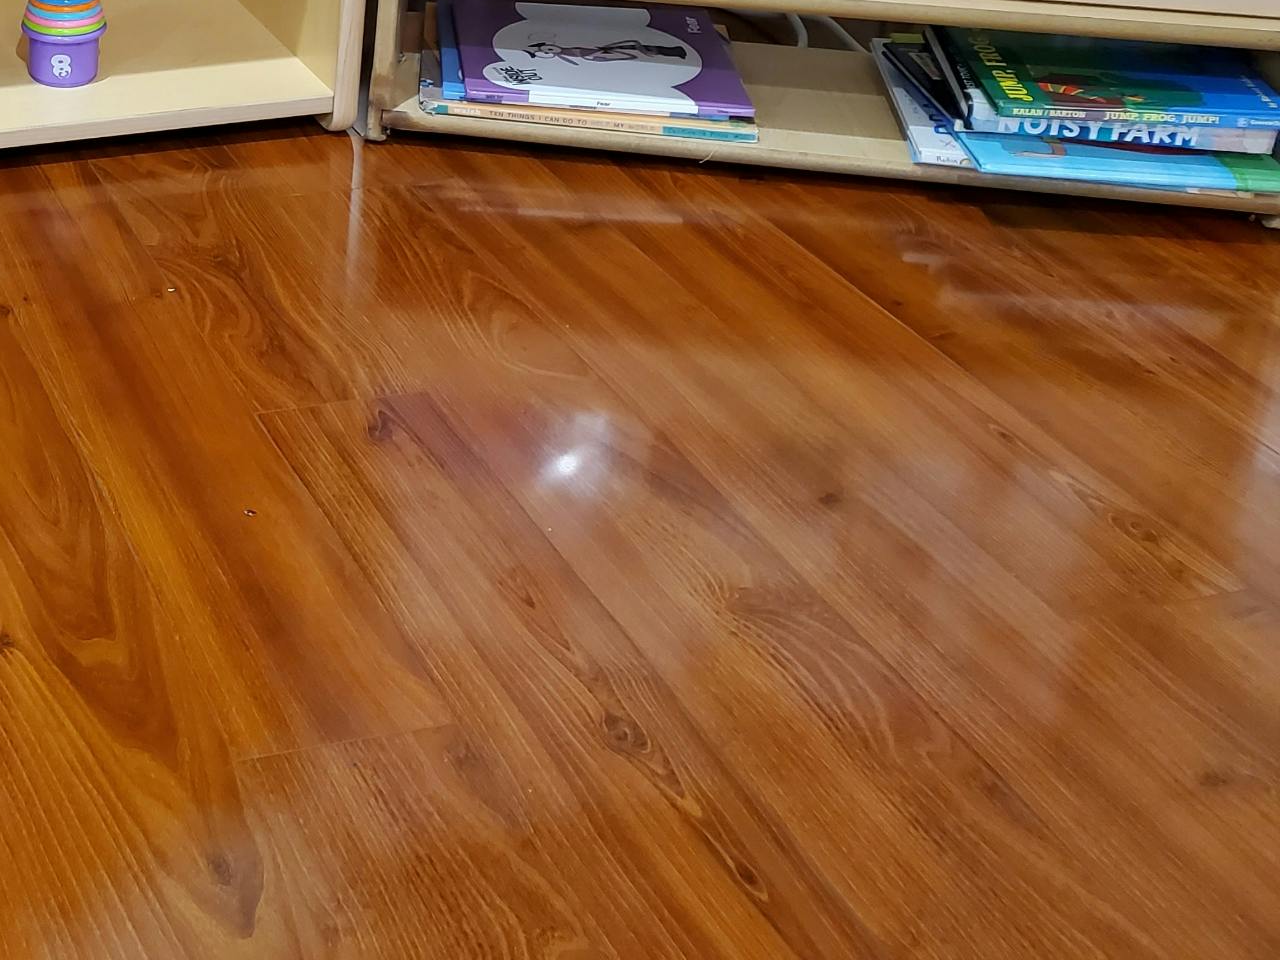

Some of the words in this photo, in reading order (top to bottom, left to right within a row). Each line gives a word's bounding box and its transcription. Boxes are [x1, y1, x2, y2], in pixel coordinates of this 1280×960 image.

[51, 54, 71, 79] 8
[991, 69, 1034, 102] JUMP,
[488, 110, 504, 118] TEN
[506, 111, 536, 121] THINGS
[544, 115, 561, 124] CAN
[562, 117, 574, 125] DO
[1012, 108, 1043, 116] KALAN
[1104, 111, 1139, 122] JUMP,
[1142, 113, 1178, 124] FROG,
[1180, 114, 1220, 125] JUMP!
[998, 116, 1104, 140] NOISY
[1110, 122, 1200, 147] FARM
